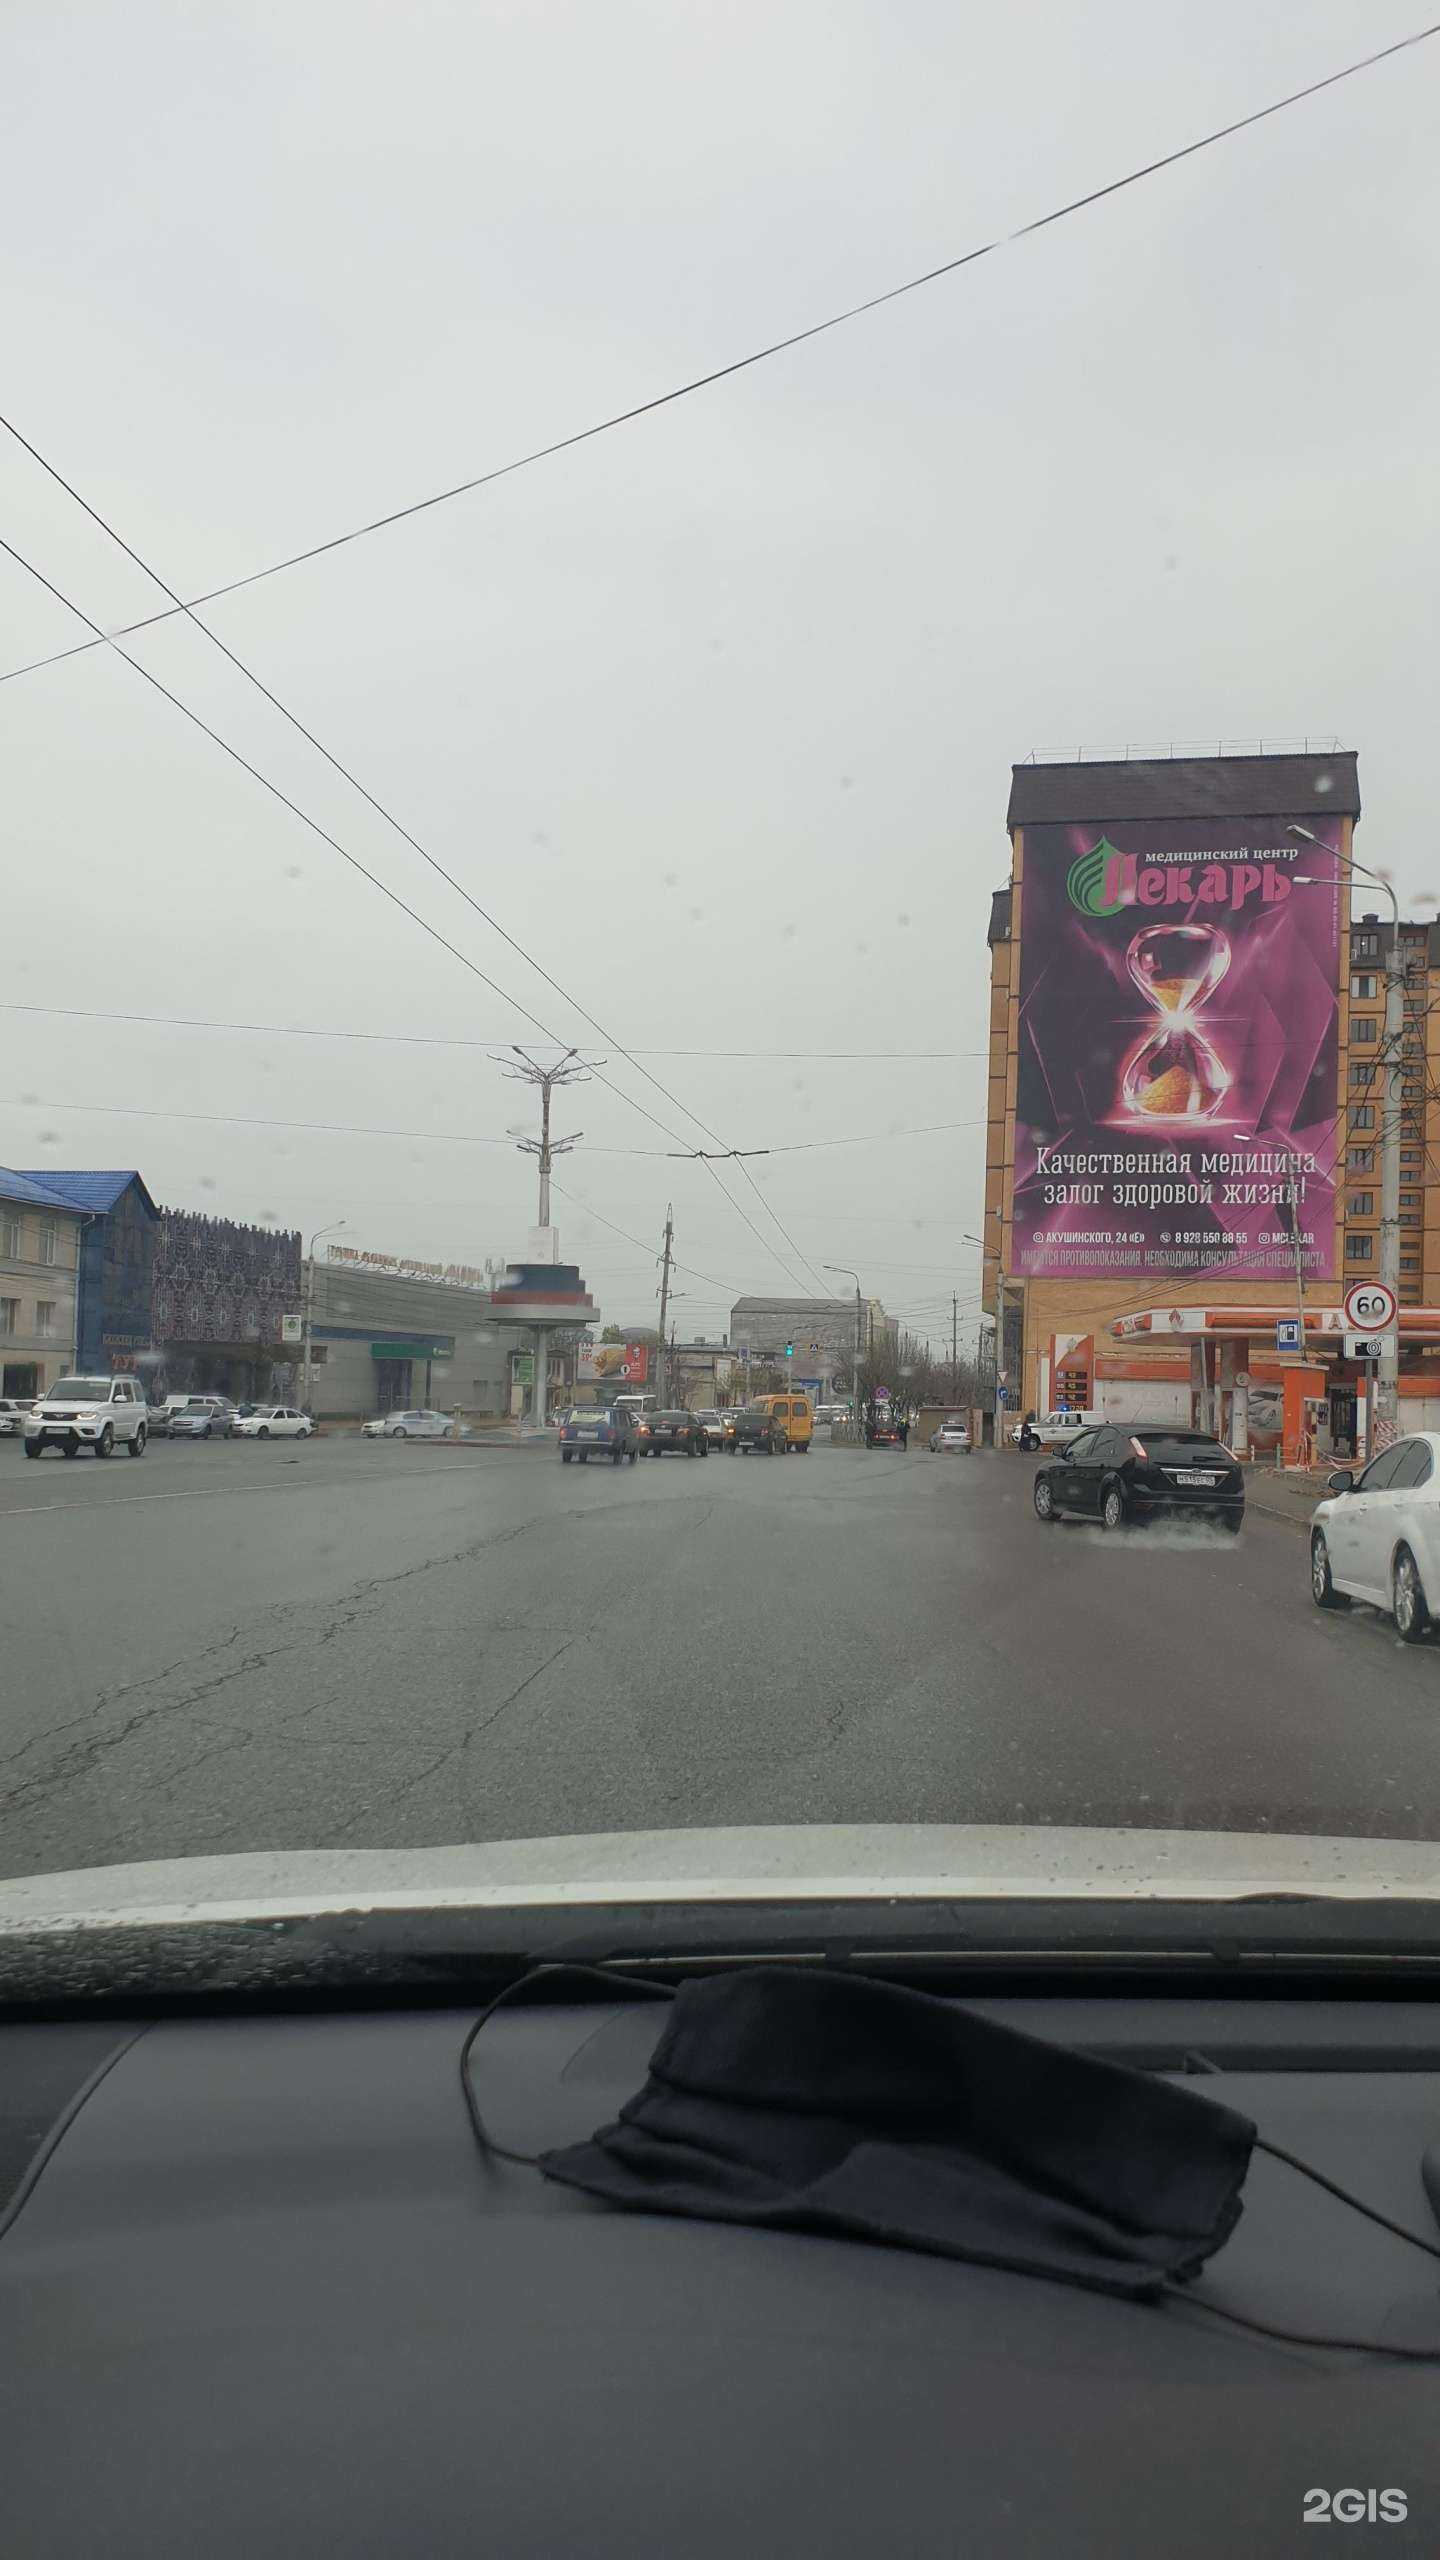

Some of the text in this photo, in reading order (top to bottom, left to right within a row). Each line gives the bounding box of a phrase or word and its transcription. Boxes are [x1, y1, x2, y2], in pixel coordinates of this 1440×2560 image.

[1145, 848, 1299, 863] медицинский центр
[1101, 852, 1292, 911] Лекарь
[1035, 1147, 1317, 1176] Качественная медицина
[1044, 1177, 1306, 1209] залог здоровой жизни!
[1045, 1231, 1114, 1244] АКУШИНСКОГО,
[1115, 1231, 1128, 1243] 24
[1175, 1231, 1248, 1244] 8 928 550 88 55
[1060, 1249, 1142, 1267] ПРОТИВОПОКАЗАНИЯ.
[1145, 1250, 1199, 1267] НЕОБХОДИМА
[1357, 1296, 1386, 1318] 60
